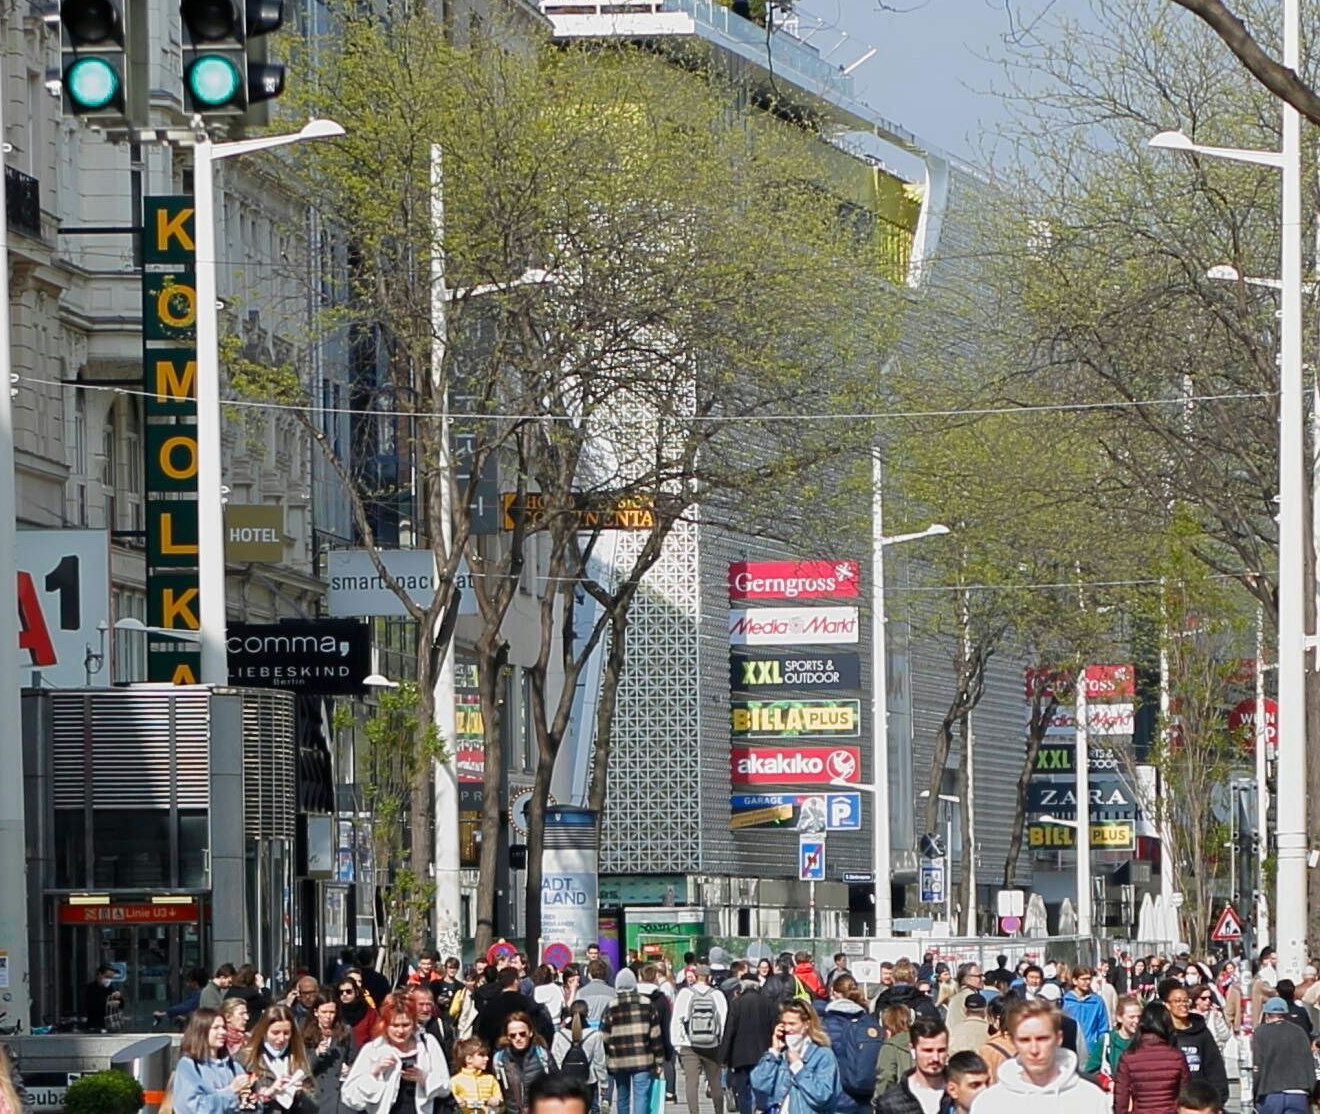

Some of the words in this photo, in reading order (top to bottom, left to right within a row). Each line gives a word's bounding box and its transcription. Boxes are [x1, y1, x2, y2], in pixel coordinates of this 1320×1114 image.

[156, 208, 199, 684] KOMOLKA
[229, 528, 280, 542] HOTEL
[735, 572, 836, 597] Gerngross
[730, 617, 788, 635] Media
[802, 615, 857, 634] Markt
[228, 666, 350, 678] LIEBESKIND
[742, 661, 784, 684] XXL
[785, 660, 824, 672] SPORTS
[825, 659, 835, 671] &
[273, 678, 305, 686] Berlin
[784, 671, 840, 684] OUTDOOR
[733, 707, 803, 731] BILLA
[809, 711, 849, 725] PLUS
[737, 752, 824, 774] akakiko
[1037, 749, 1072, 769] XXL
[743, 796, 784, 805] GARAGE
[1040, 788, 1129, 805] ZARA
[1030, 826, 1073, 846] BILL
[1093, 829, 1126, 841] PLUS
[544, 891, 587, 905] LAND
[126, 907, 151, 918] Linie
